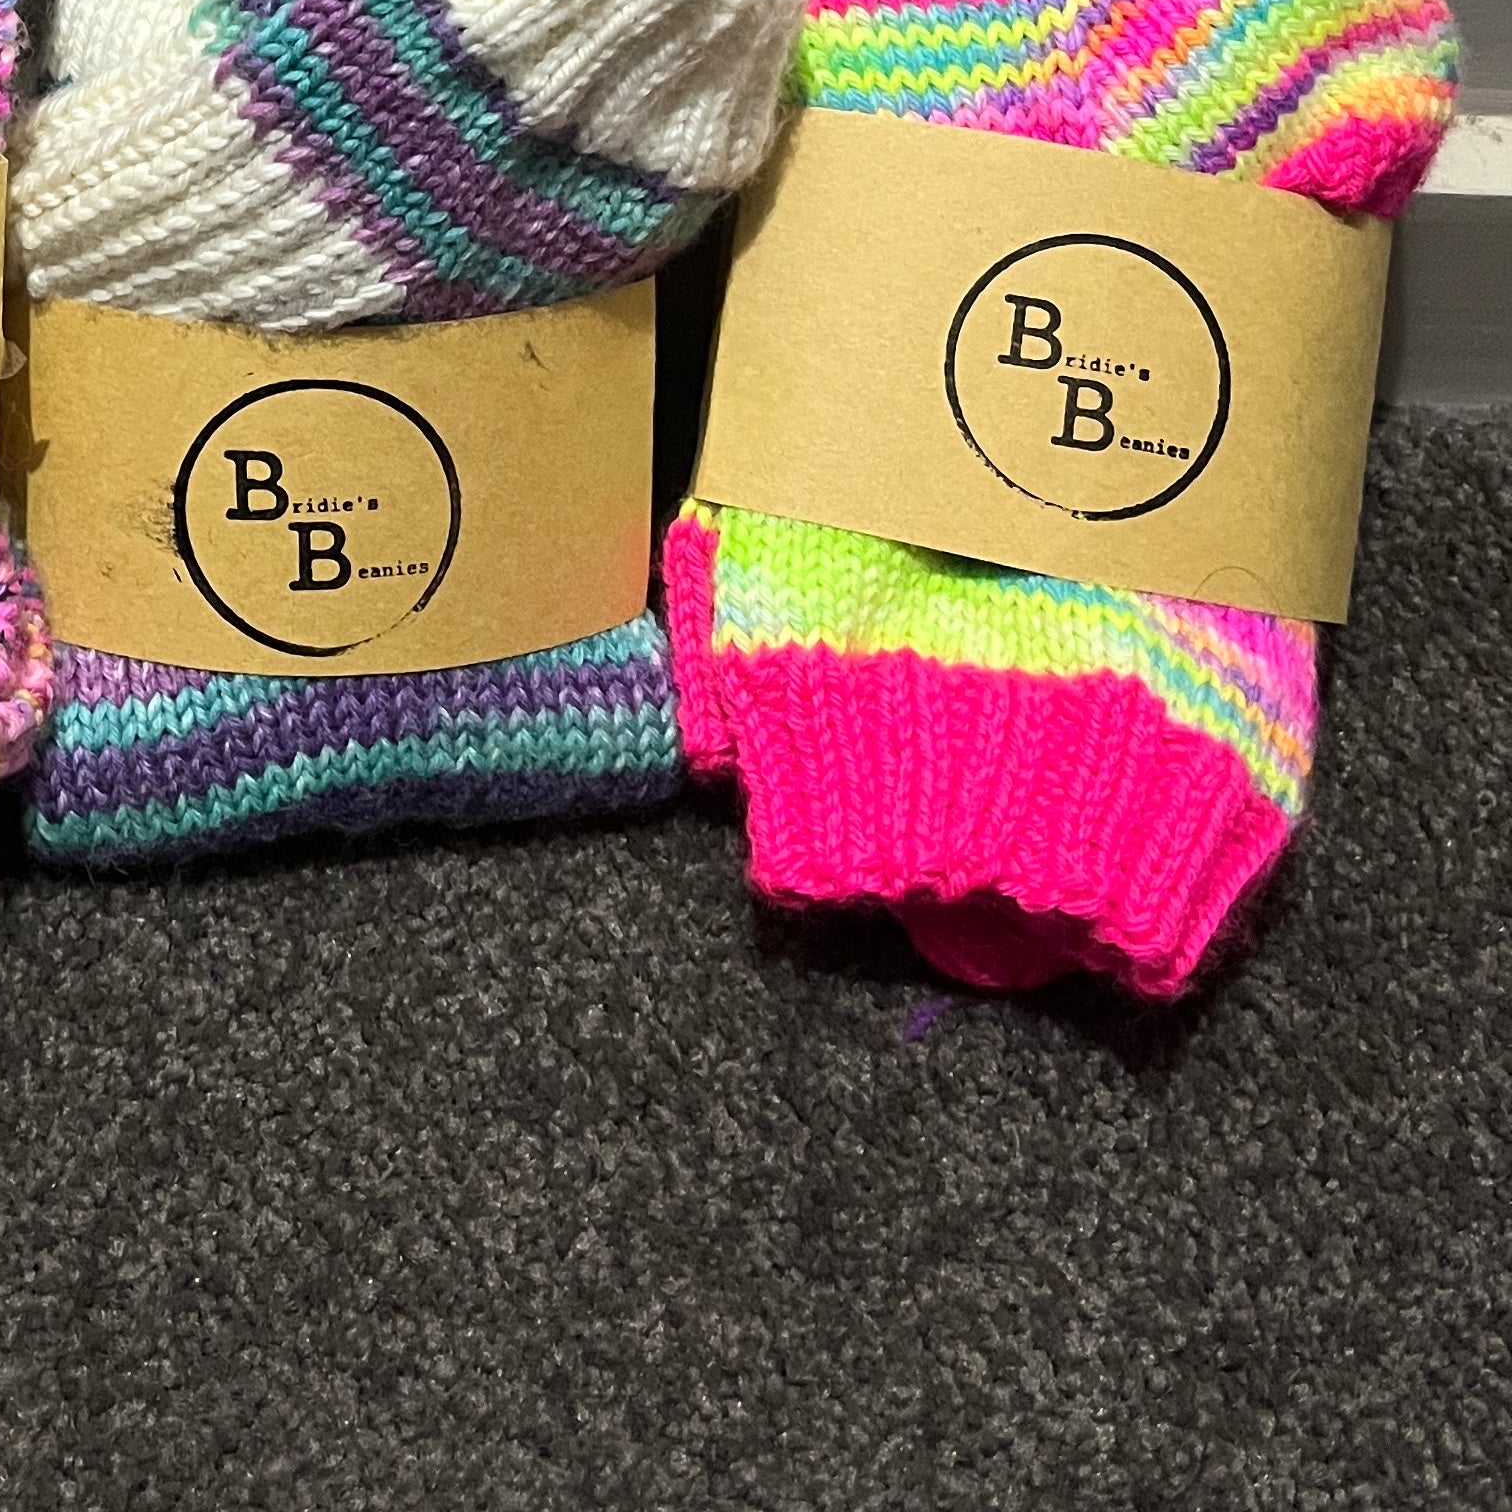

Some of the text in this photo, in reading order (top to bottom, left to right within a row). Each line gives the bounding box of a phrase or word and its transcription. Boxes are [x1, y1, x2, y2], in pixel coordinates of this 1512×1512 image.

[998, 294, 1150, 381] Bridie's
[1051, 375, 1189, 460] Beanies
[224, 450, 379, 520] Bridie's
[288, 521, 429, 591] Beanies
